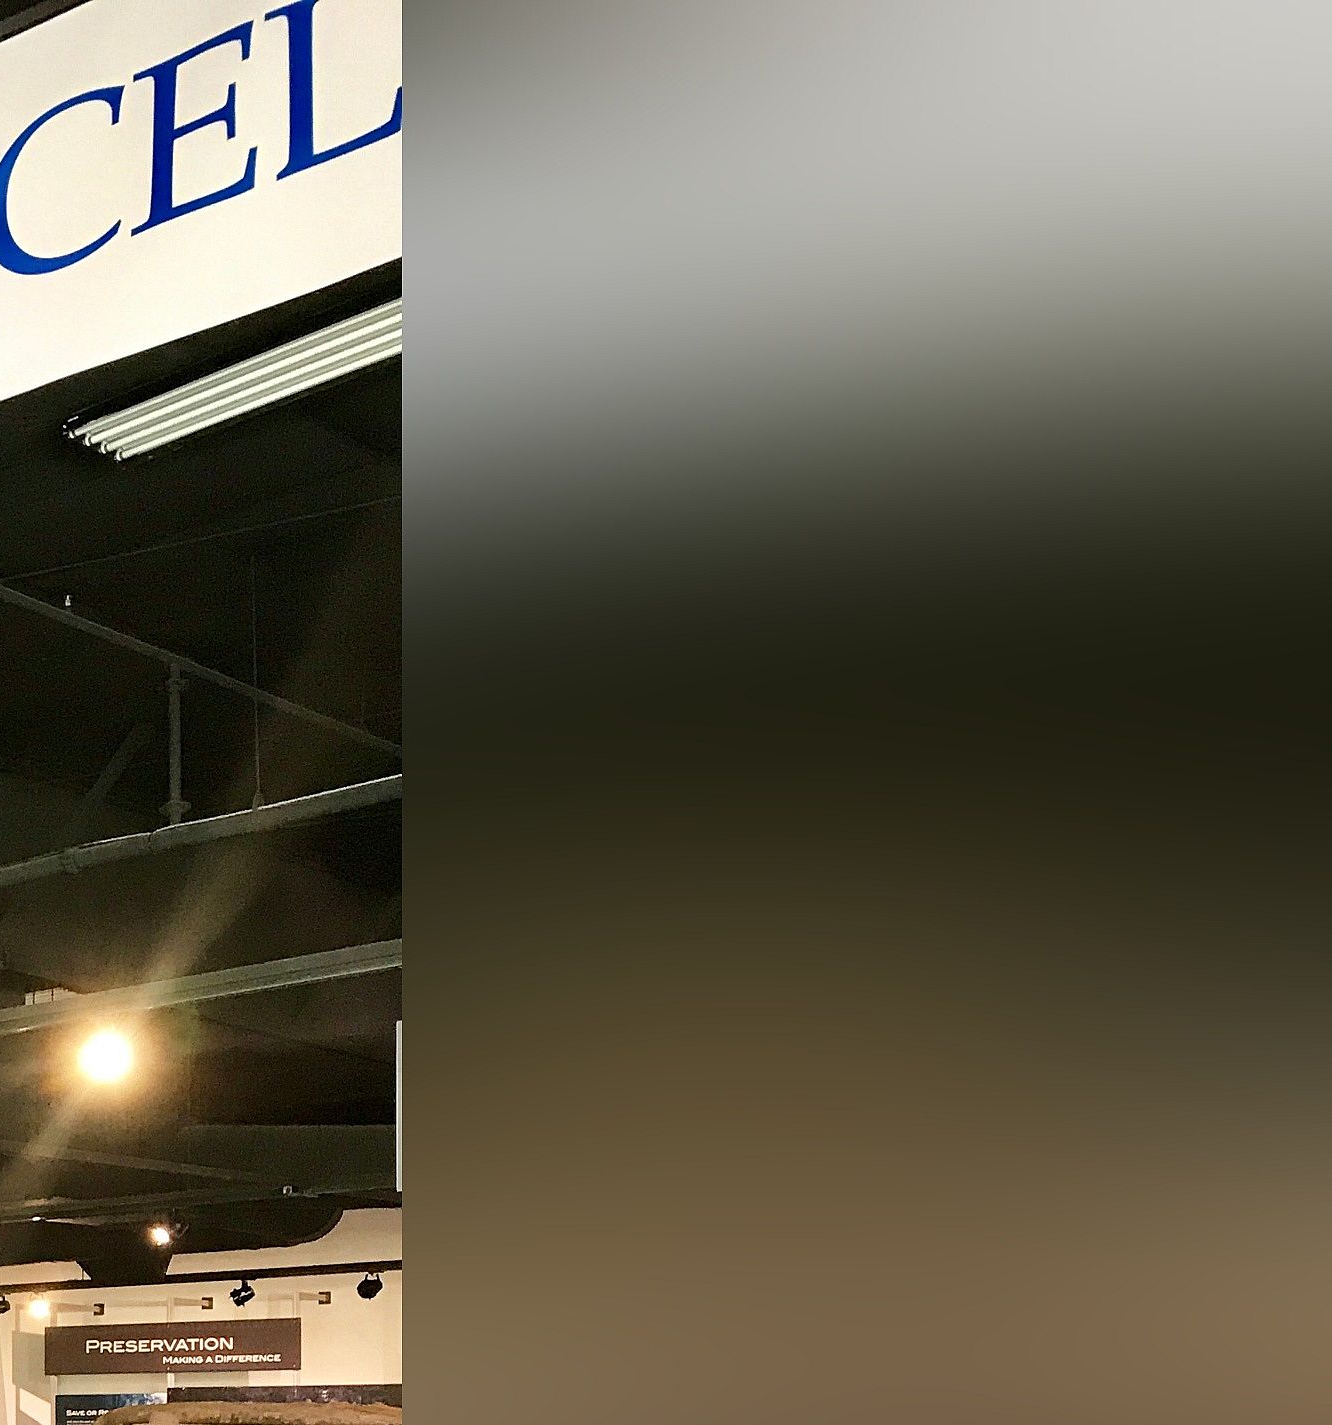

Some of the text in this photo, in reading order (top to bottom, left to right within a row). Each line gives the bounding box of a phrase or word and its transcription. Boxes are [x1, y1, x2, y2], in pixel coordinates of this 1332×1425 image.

[85, 1336, 234, 1354] PRESERVATION
[162, 1353, 282, 1364] MAKING A DIFFERENCE
